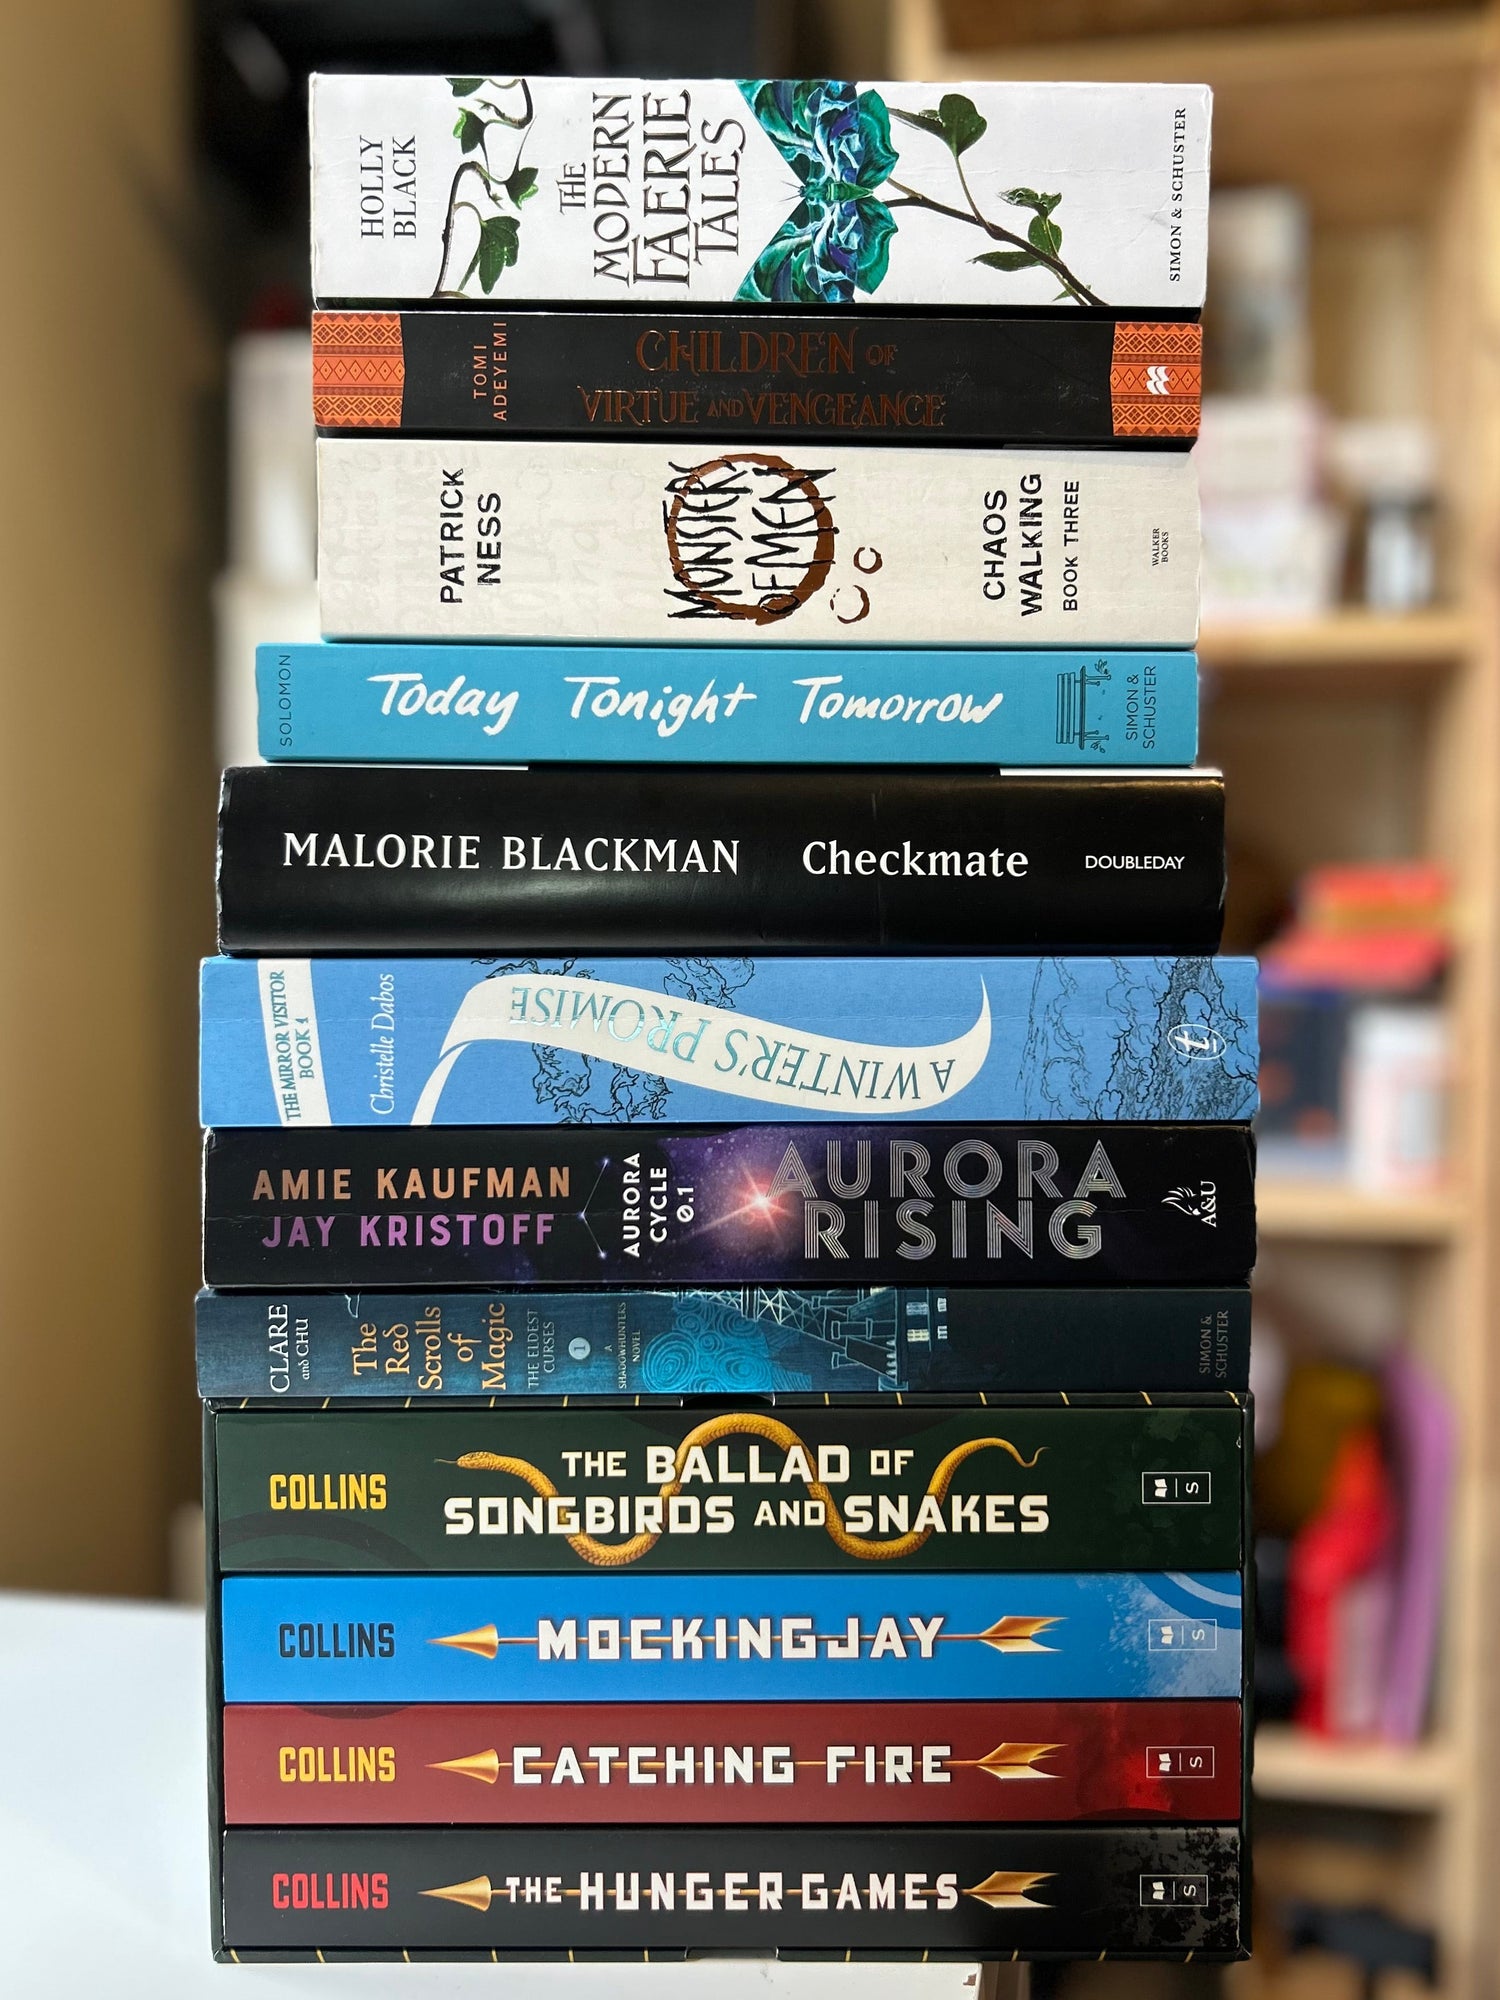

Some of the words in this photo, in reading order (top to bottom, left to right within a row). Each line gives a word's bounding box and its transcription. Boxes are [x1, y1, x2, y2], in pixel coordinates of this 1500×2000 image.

[1171, 107, 1186, 202] SCHUSTER
[360, 134, 385, 239] HOLLY
[393, 135, 417, 239] BLACK
[556, 161, 587, 215] THE
[593, 92, 635, 288] MODERN
[630, 89, 697, 288] FAERIE
[693, 118, 746, 265] TALES
[1171, 209, 1182, 219] &
[1169, 226, 1181, 282] SIMON
[473, 343, 488, 399] TOMI
[493, 321, 507, 422] ADEYEMI
[635, 327, 859, 377] CHILDREN
[865, 344, 898, 367] OF
[576, 385, 700, 426] VIRTUE
[706, 397, 745, 418] AND
[743, 388, 946, 428] VENGEANCE
[440, 468, 466, 603] PATRICK
[476, 491, 501, 585] NESS
[662, 459, 753, 620] MONSTERS
[744, 468, 840, 568] MEN
[1063, 480, 1080, 547] THREE
[982, 488, 1008, 601] CHAOS
[1018, 473, 1043, 617] WALKING
[1152, 527, 1160, 567] WALKER
[1161, 531, 1169, 563] BOOKS
[752, 573, 803, 615] OF
[1063, 557, 1078, 612] BOOK
[279, 654, 292, 747] SOLOMON
[367, 673, 520, 736] Today
[563, 676, 757, 738] Tonight
[792, 675, 1004, 724] Tomorrow
[1127, 674, 1139, 685] &
[1125, 688, 1139, 741] SIMON
[1142, 665, 1157, 750] SCHUSTER
[283, 832, 481, 869] MALORIE
[502, 836, 740, 875] BLACKMAN
[802, 839, 1029, 877] Checkmate
[1085, 854, 1185, 870] DOUBLEDAY
[270, 970, 289, 1028] VISITOR
[370, 973, 395, 1031] Dabos
[509, 985, 713, 1063] PROMISE
[275, 1032, 296, 1090] MIRROR
[294, 1029, 315, 1079] BOOK
[369, 1036, 395, 1114] Christelle
[714, 1028, 921, 1100] WINTER'S
[929, 1059, 956, 1093] A
[283, 1093, 301, 1121] THE
[252, 1168, 352, 1201] AMIE
[377, 1166, 570, 1199] KAUFMAN
[764, 1139, 1127, 1199] AURORA
[262, 1215, 337, 1248] JAY
[360, 1213, 555, 1247] KRISTOFF
[623, 1152, 641, 1258] AURORA
[650, 1166, 668, 1243] CYCLE
[804, 1200, 1102, 1260] RISING
[1200, 1180, 1217, 1228] A&U
[296, 1318, 309, 1357] CHU
[527, 1309, 540, 1359] ELDEST
[617, 1302, 627, 1389] SHADOWHUNTERS
[632, 1330, 640, 1362] NOVEL
[1200, 1314, 1212, 1325] &
[1215, 1310, 1229, 1378] SCHUSTER
[268, 1304, 290, 1393] CLARE
[298, 1360, 310, 1380] and
[352, 1323, 378, 1376] The
[383, 1324, 410, 1375] Red
[415, 1306, 443, 1390] Scrolls
[447, 1333, 482, 1363] of
[481, 1303, 514, 1390] Magic
[542, 1321, 555, 1373] CURSES
[1199, 1329, 1212, 1374] SIMON
[527, 1362, 540, 1389] THE
[562, 1451, 627, 1478] THE
[646, 1445, 850, 1484] BALLAD
[870, 1449, 915, 1476] OF
[269, 1473, 387, 1511] COLLINS
[443, 1495, 735, 1535] SONGBIRDS
[753, 1500, 826, 1527] AND
[844, 1494, 1050, 1533] SNAKES
[279, 1622, 395, 1659] COLLINS
[537, 1616, 945, 1661] MOCKINGJAY
[279, 1746, 396, 1783] COLLINS
[512, 1745, 796, 1785] CATCHING
[826, 1745, 952, 1784] FIRE
[272, 1872, 390, 1910] COLLINS
[506, 1876, 562, 1903] THE
[580, 1872, 783, 1911] HUNGER
[801, 1872, 958, 1910] GAMES
